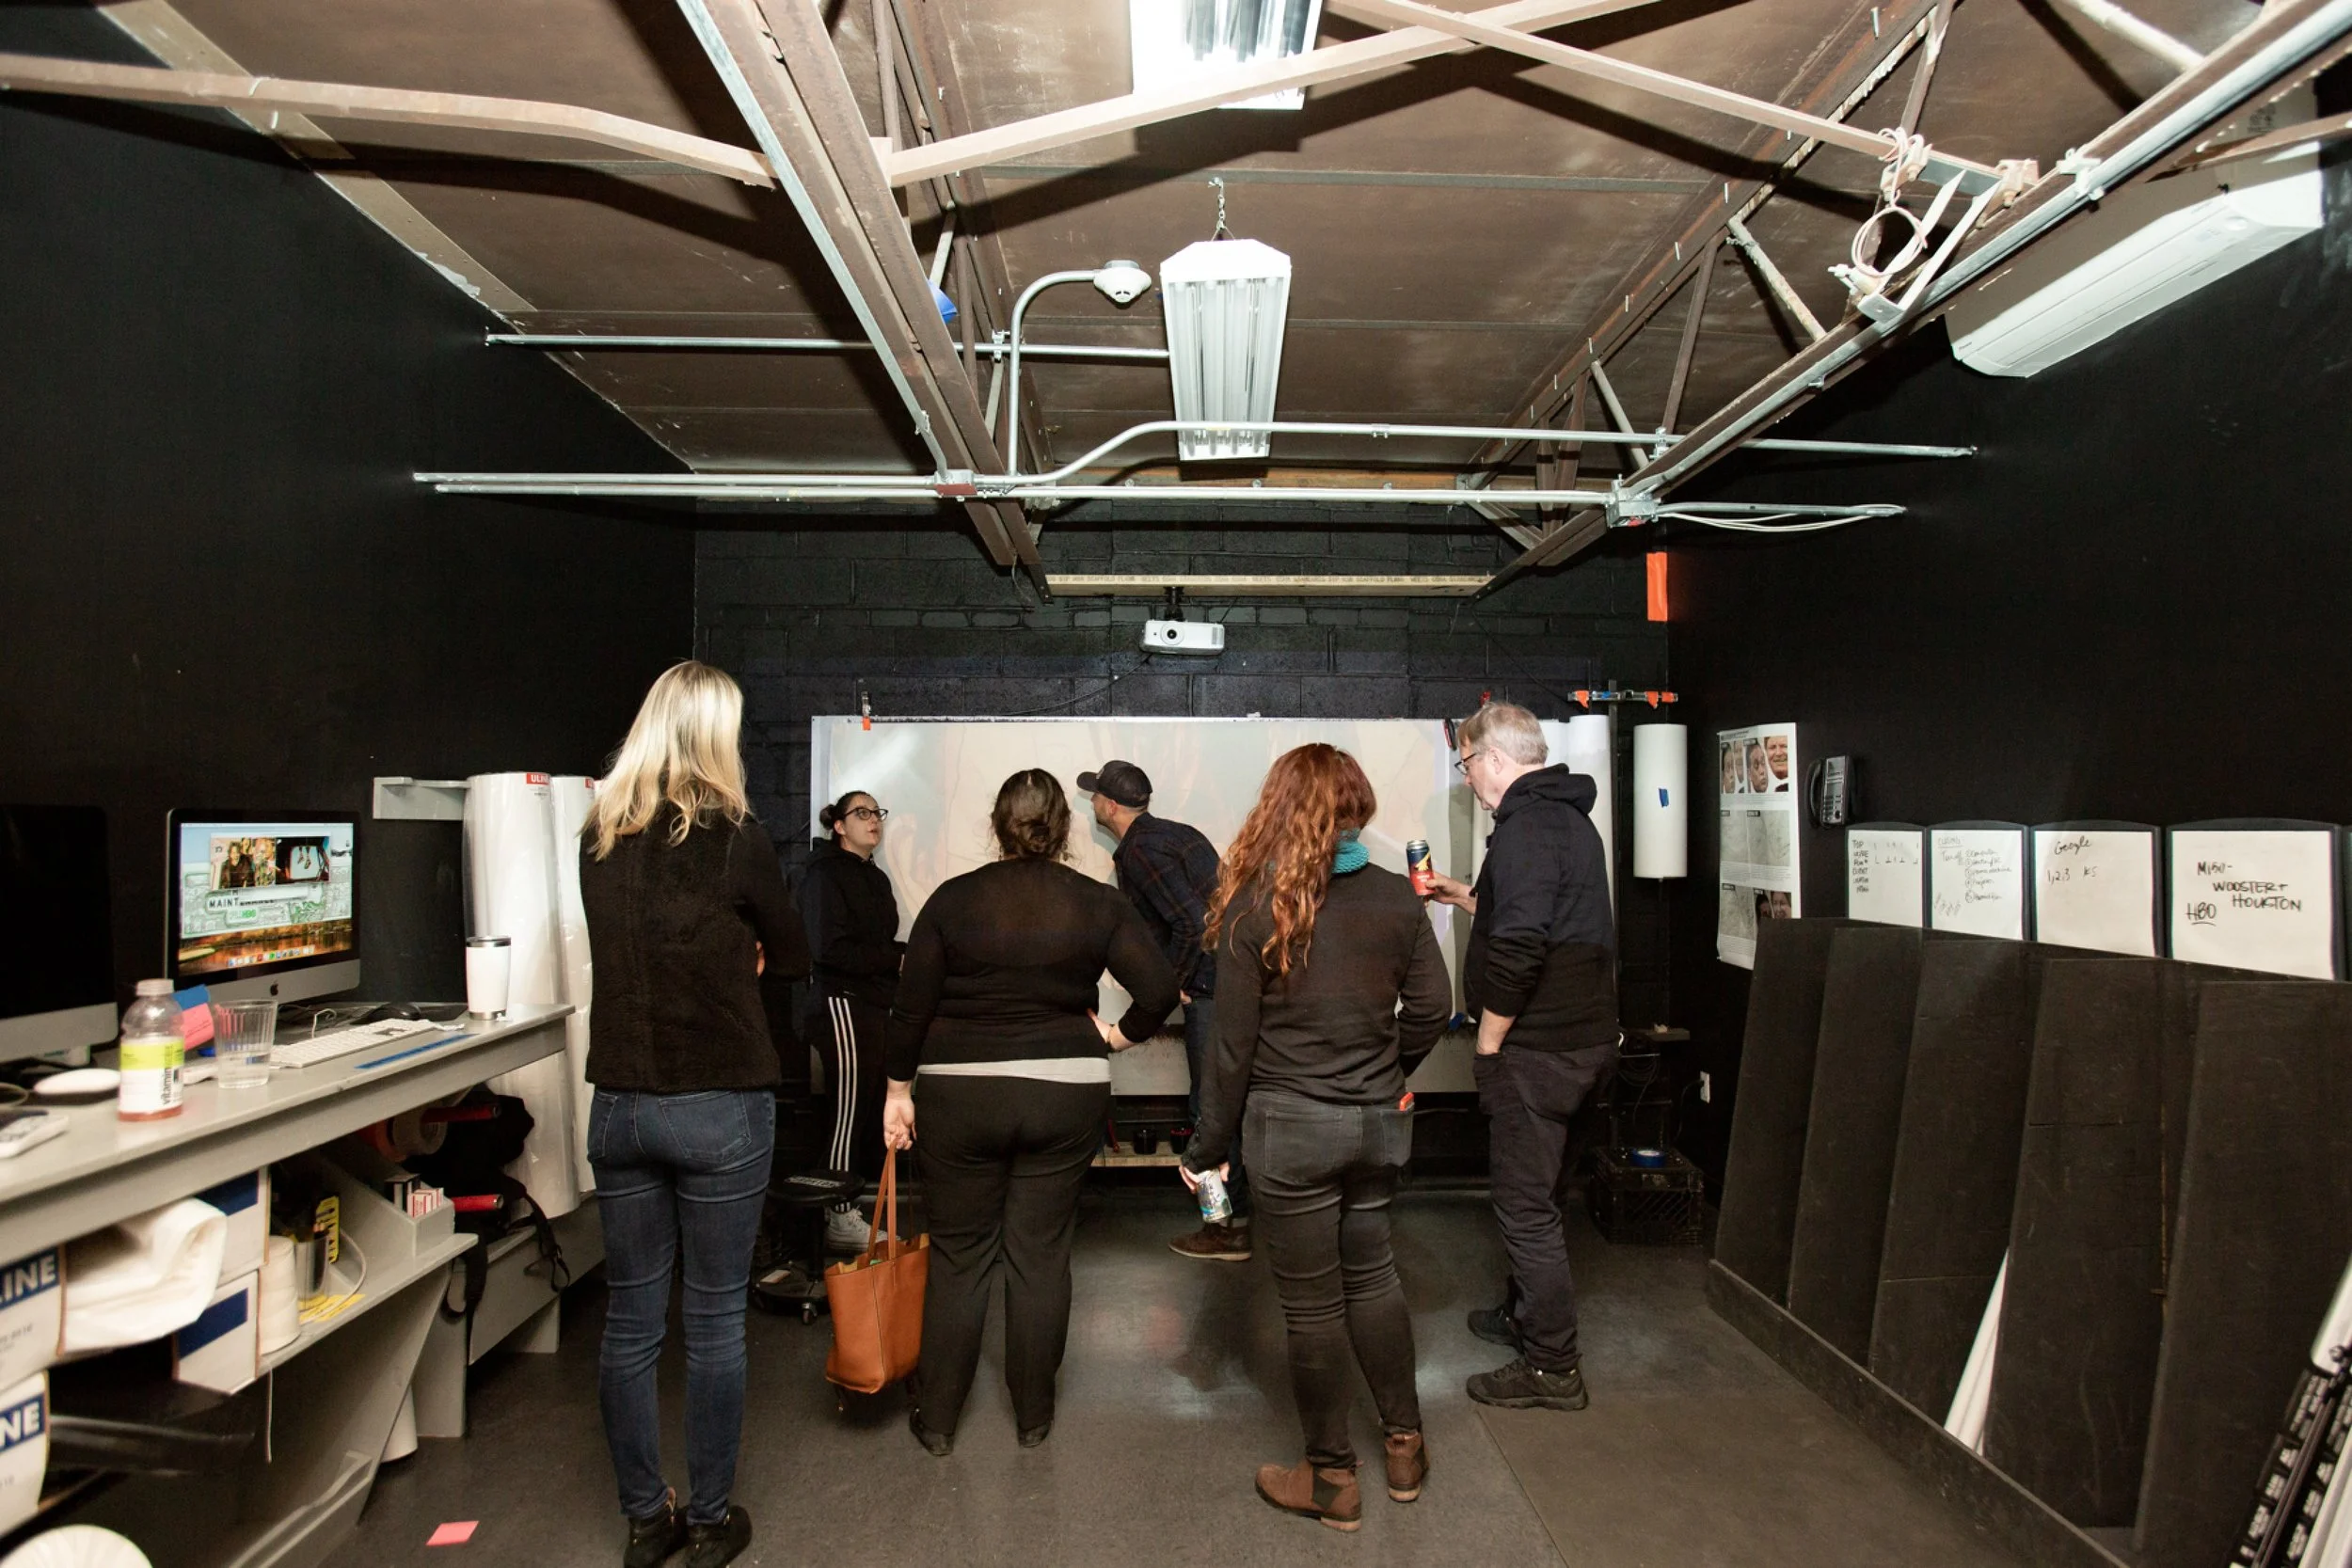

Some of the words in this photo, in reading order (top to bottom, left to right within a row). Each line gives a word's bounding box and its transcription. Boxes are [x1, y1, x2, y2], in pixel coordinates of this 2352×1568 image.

[2054, 835, 2091, 855] Google
[2185, 902, 2217, 921] HBO
[0, 1254, 56, 1305] INE
